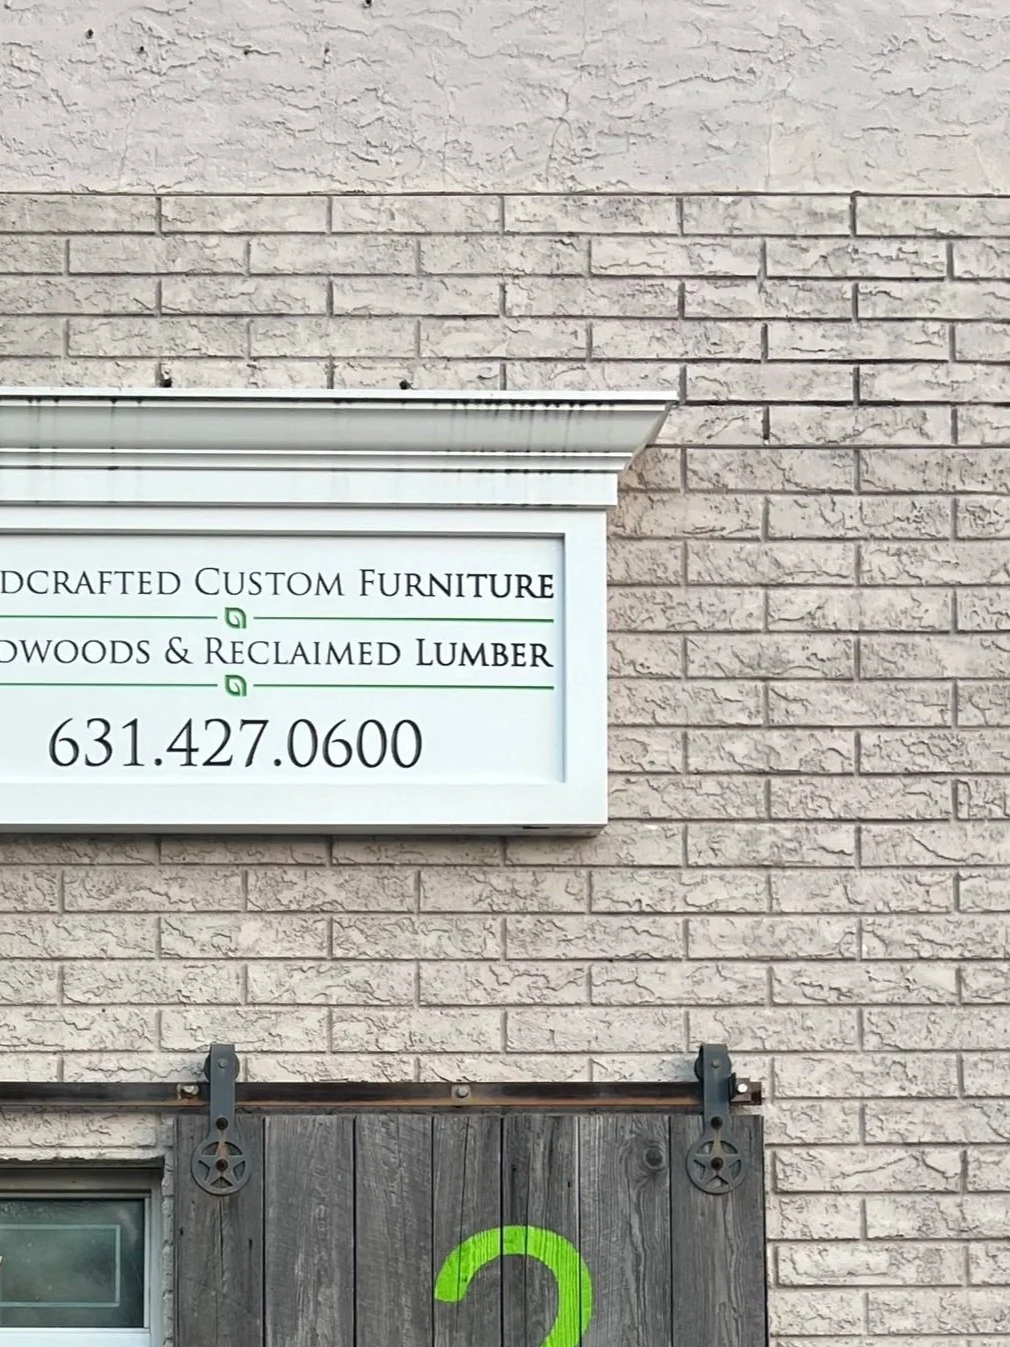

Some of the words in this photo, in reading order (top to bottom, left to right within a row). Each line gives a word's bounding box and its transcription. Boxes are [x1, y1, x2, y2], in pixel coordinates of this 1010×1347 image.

[195, 567, 344, 597] CUSTOM
[360, 568, 554, 599] FURNITURE
[165, 636, 192, 665] &
[205, 637, 401, 667] RECLAIMED
[416, 638, 554, 668] LUMBER
[48, 717, 423, 769] 631.427.0600
